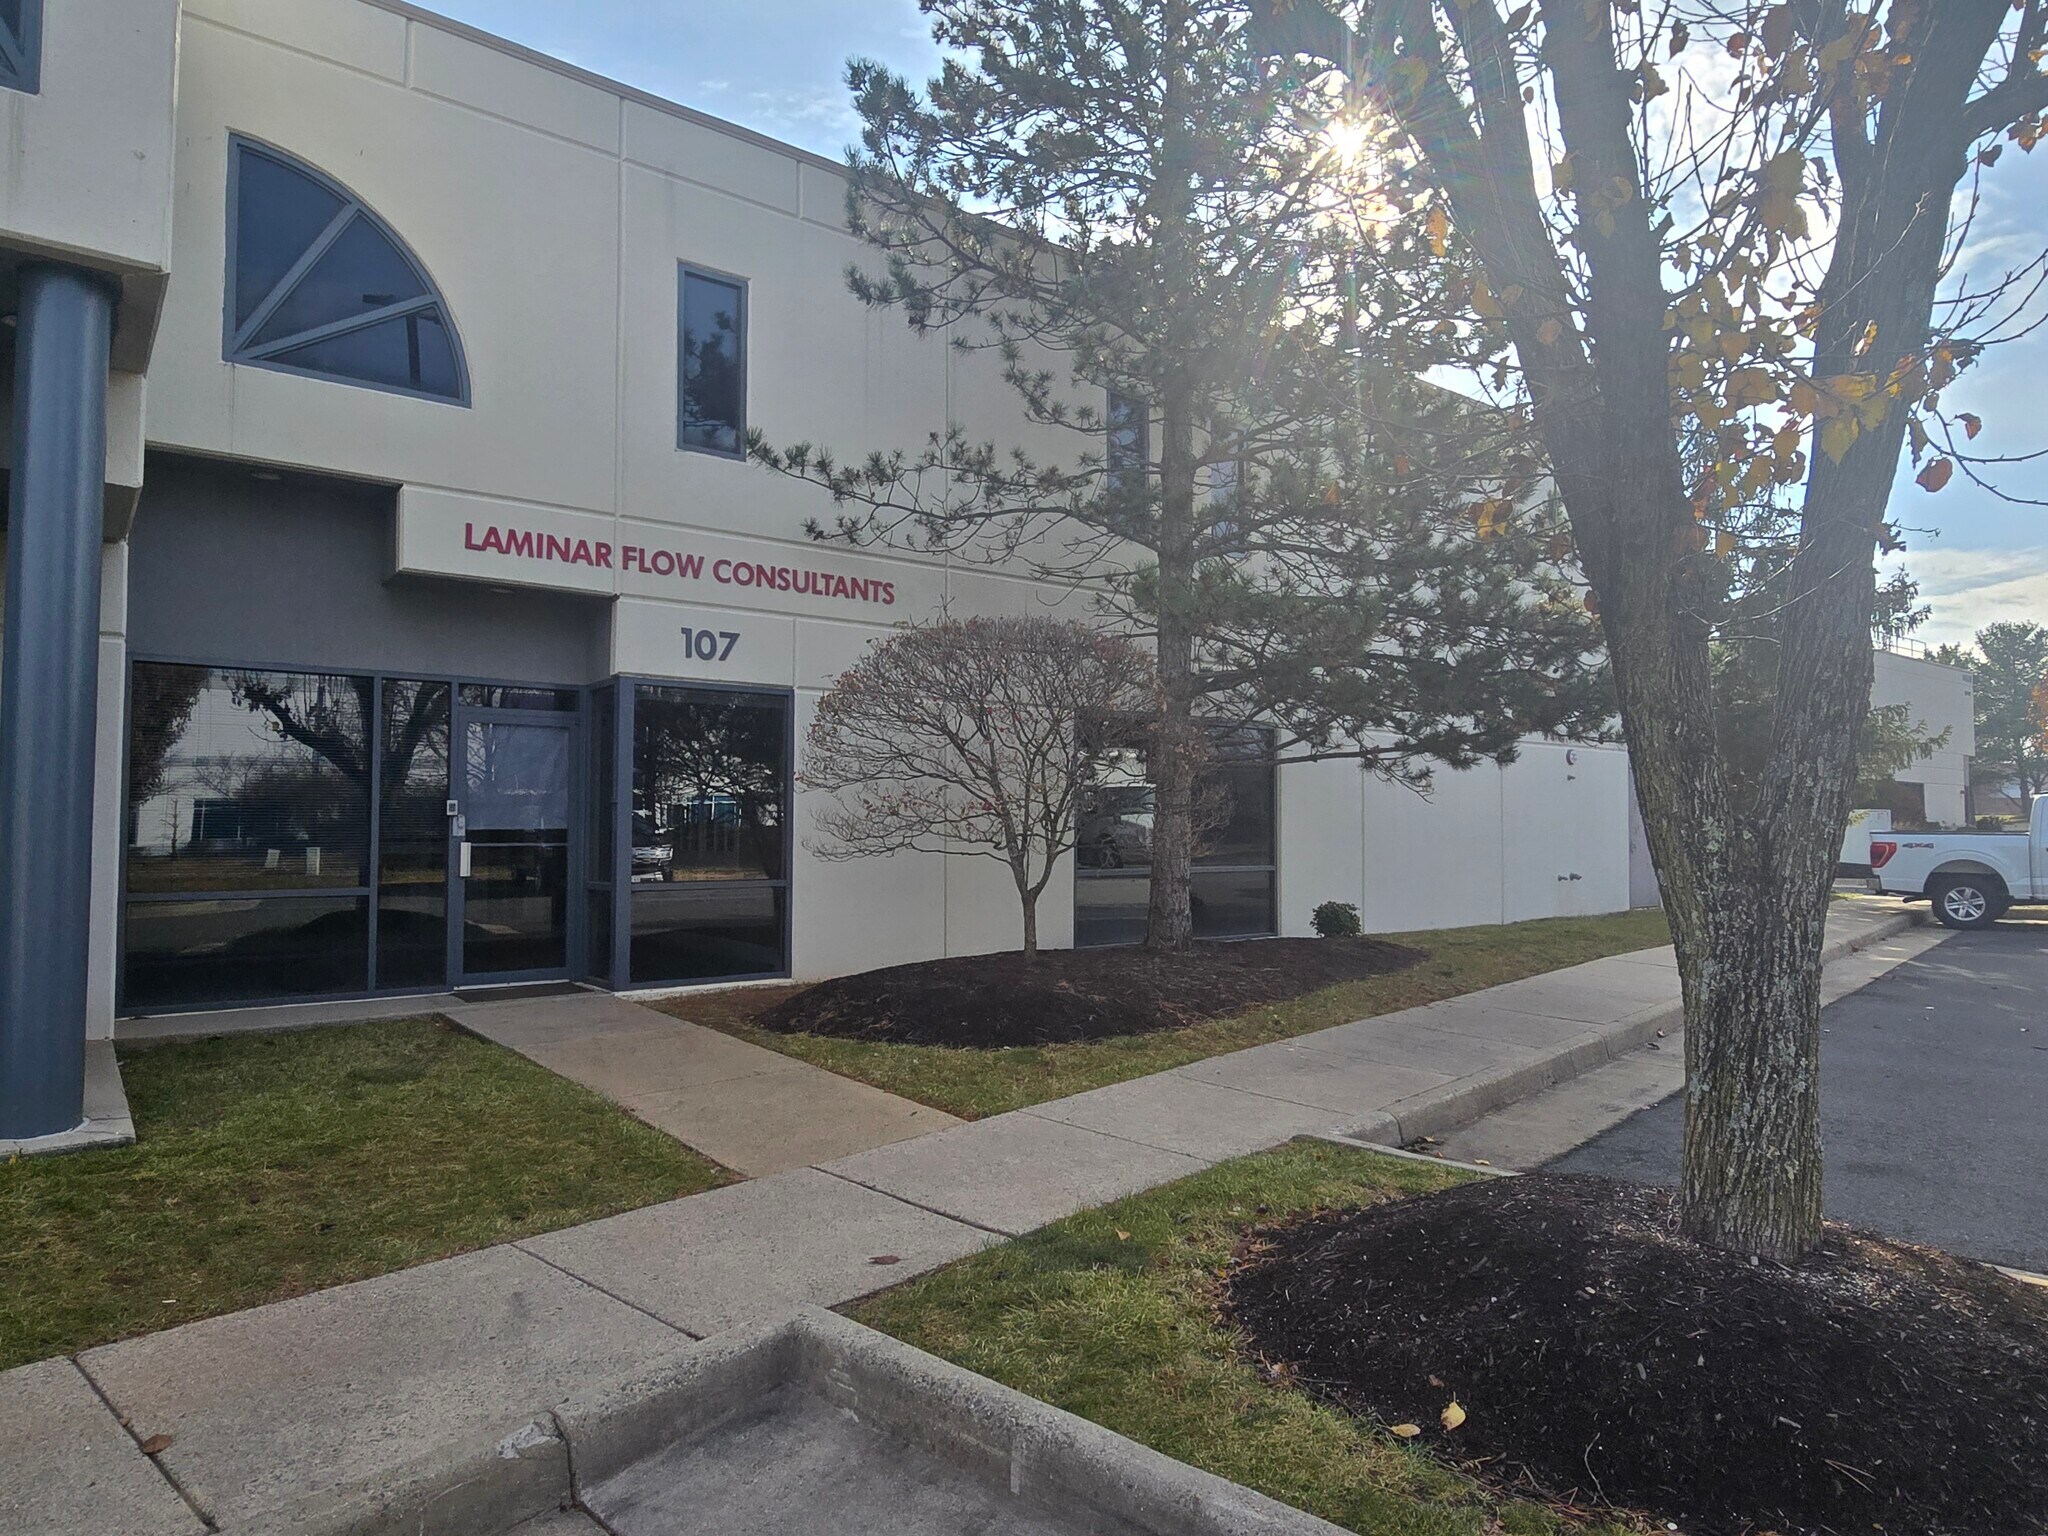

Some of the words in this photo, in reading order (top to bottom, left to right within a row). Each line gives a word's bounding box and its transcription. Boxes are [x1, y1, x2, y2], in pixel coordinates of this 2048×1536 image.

[464, 522, 612, 569] LAMINAR
[621, 545, 705, 579] FLOW
[712, 558, 895, 605] CONSULTANTS
[680, 627, 740, 662] 107
